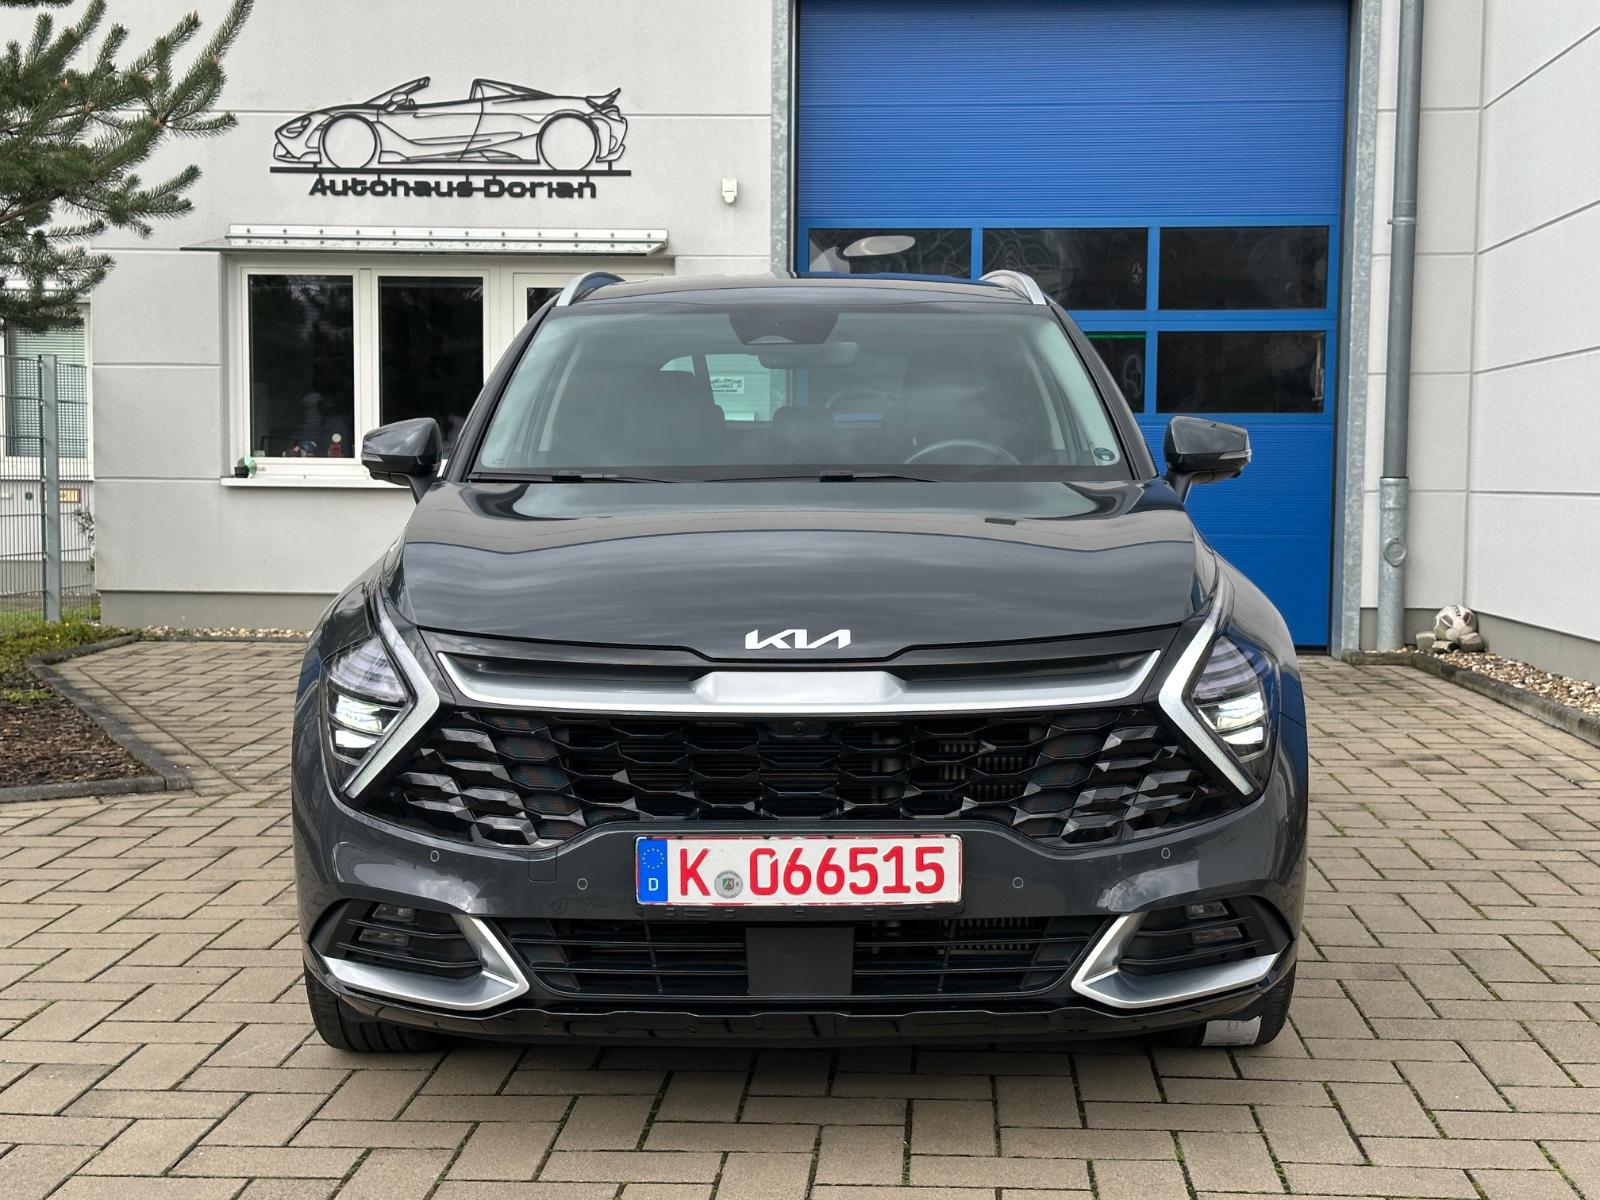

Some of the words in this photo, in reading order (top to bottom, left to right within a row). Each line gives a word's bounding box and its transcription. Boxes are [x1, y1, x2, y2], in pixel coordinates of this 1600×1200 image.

[745, 629, 851, 649] KIA
[679, 848, 711, 896] K
[749, 845, 945, 896] 066515
[648, 877, 659, 892] D
